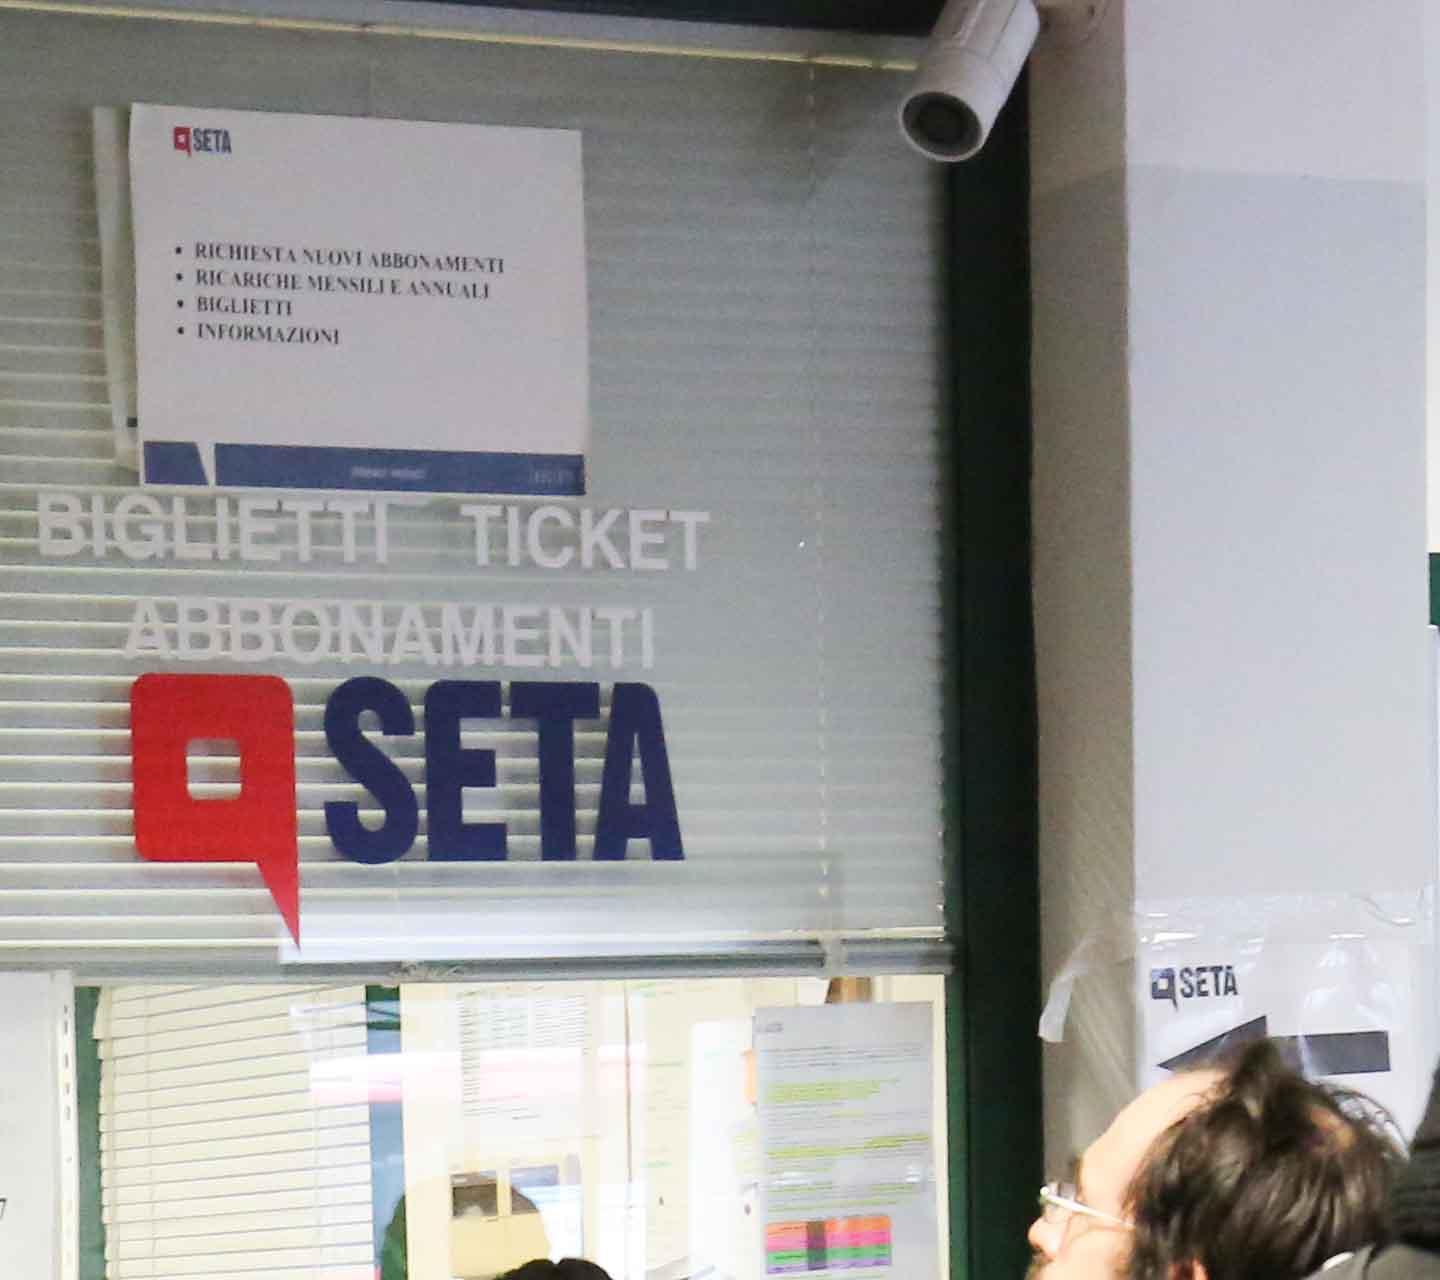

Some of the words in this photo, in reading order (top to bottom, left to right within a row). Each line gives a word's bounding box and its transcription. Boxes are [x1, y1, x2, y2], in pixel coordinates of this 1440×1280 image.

[192, 128, 232, 154] SETA
[194, 242, 297, 265] RICHIESTA
[302, 248, 362, 268] NUOVI
[368, 251, 506, 275] ABBONAMENTI
[195, 270, 301, 292] RICARICHE
[307, 274, 385, 296] MENSILI
[390, 279, 403, 297] E
[408, 279, 490, 300] ANNUALI
[196, 297, 293, 317] BIGLIETTI
[197, 324, 341, 346] INFORMAZIONI
[36, 490, 388, 564] BIGLIETTI
[460, 503, 711, 572] TICKET
[121, 600, 655, 670] ABBONAMENTI
[323, 675, 686, 866] SETA
[1180, 965, 1239, 999] SETA
